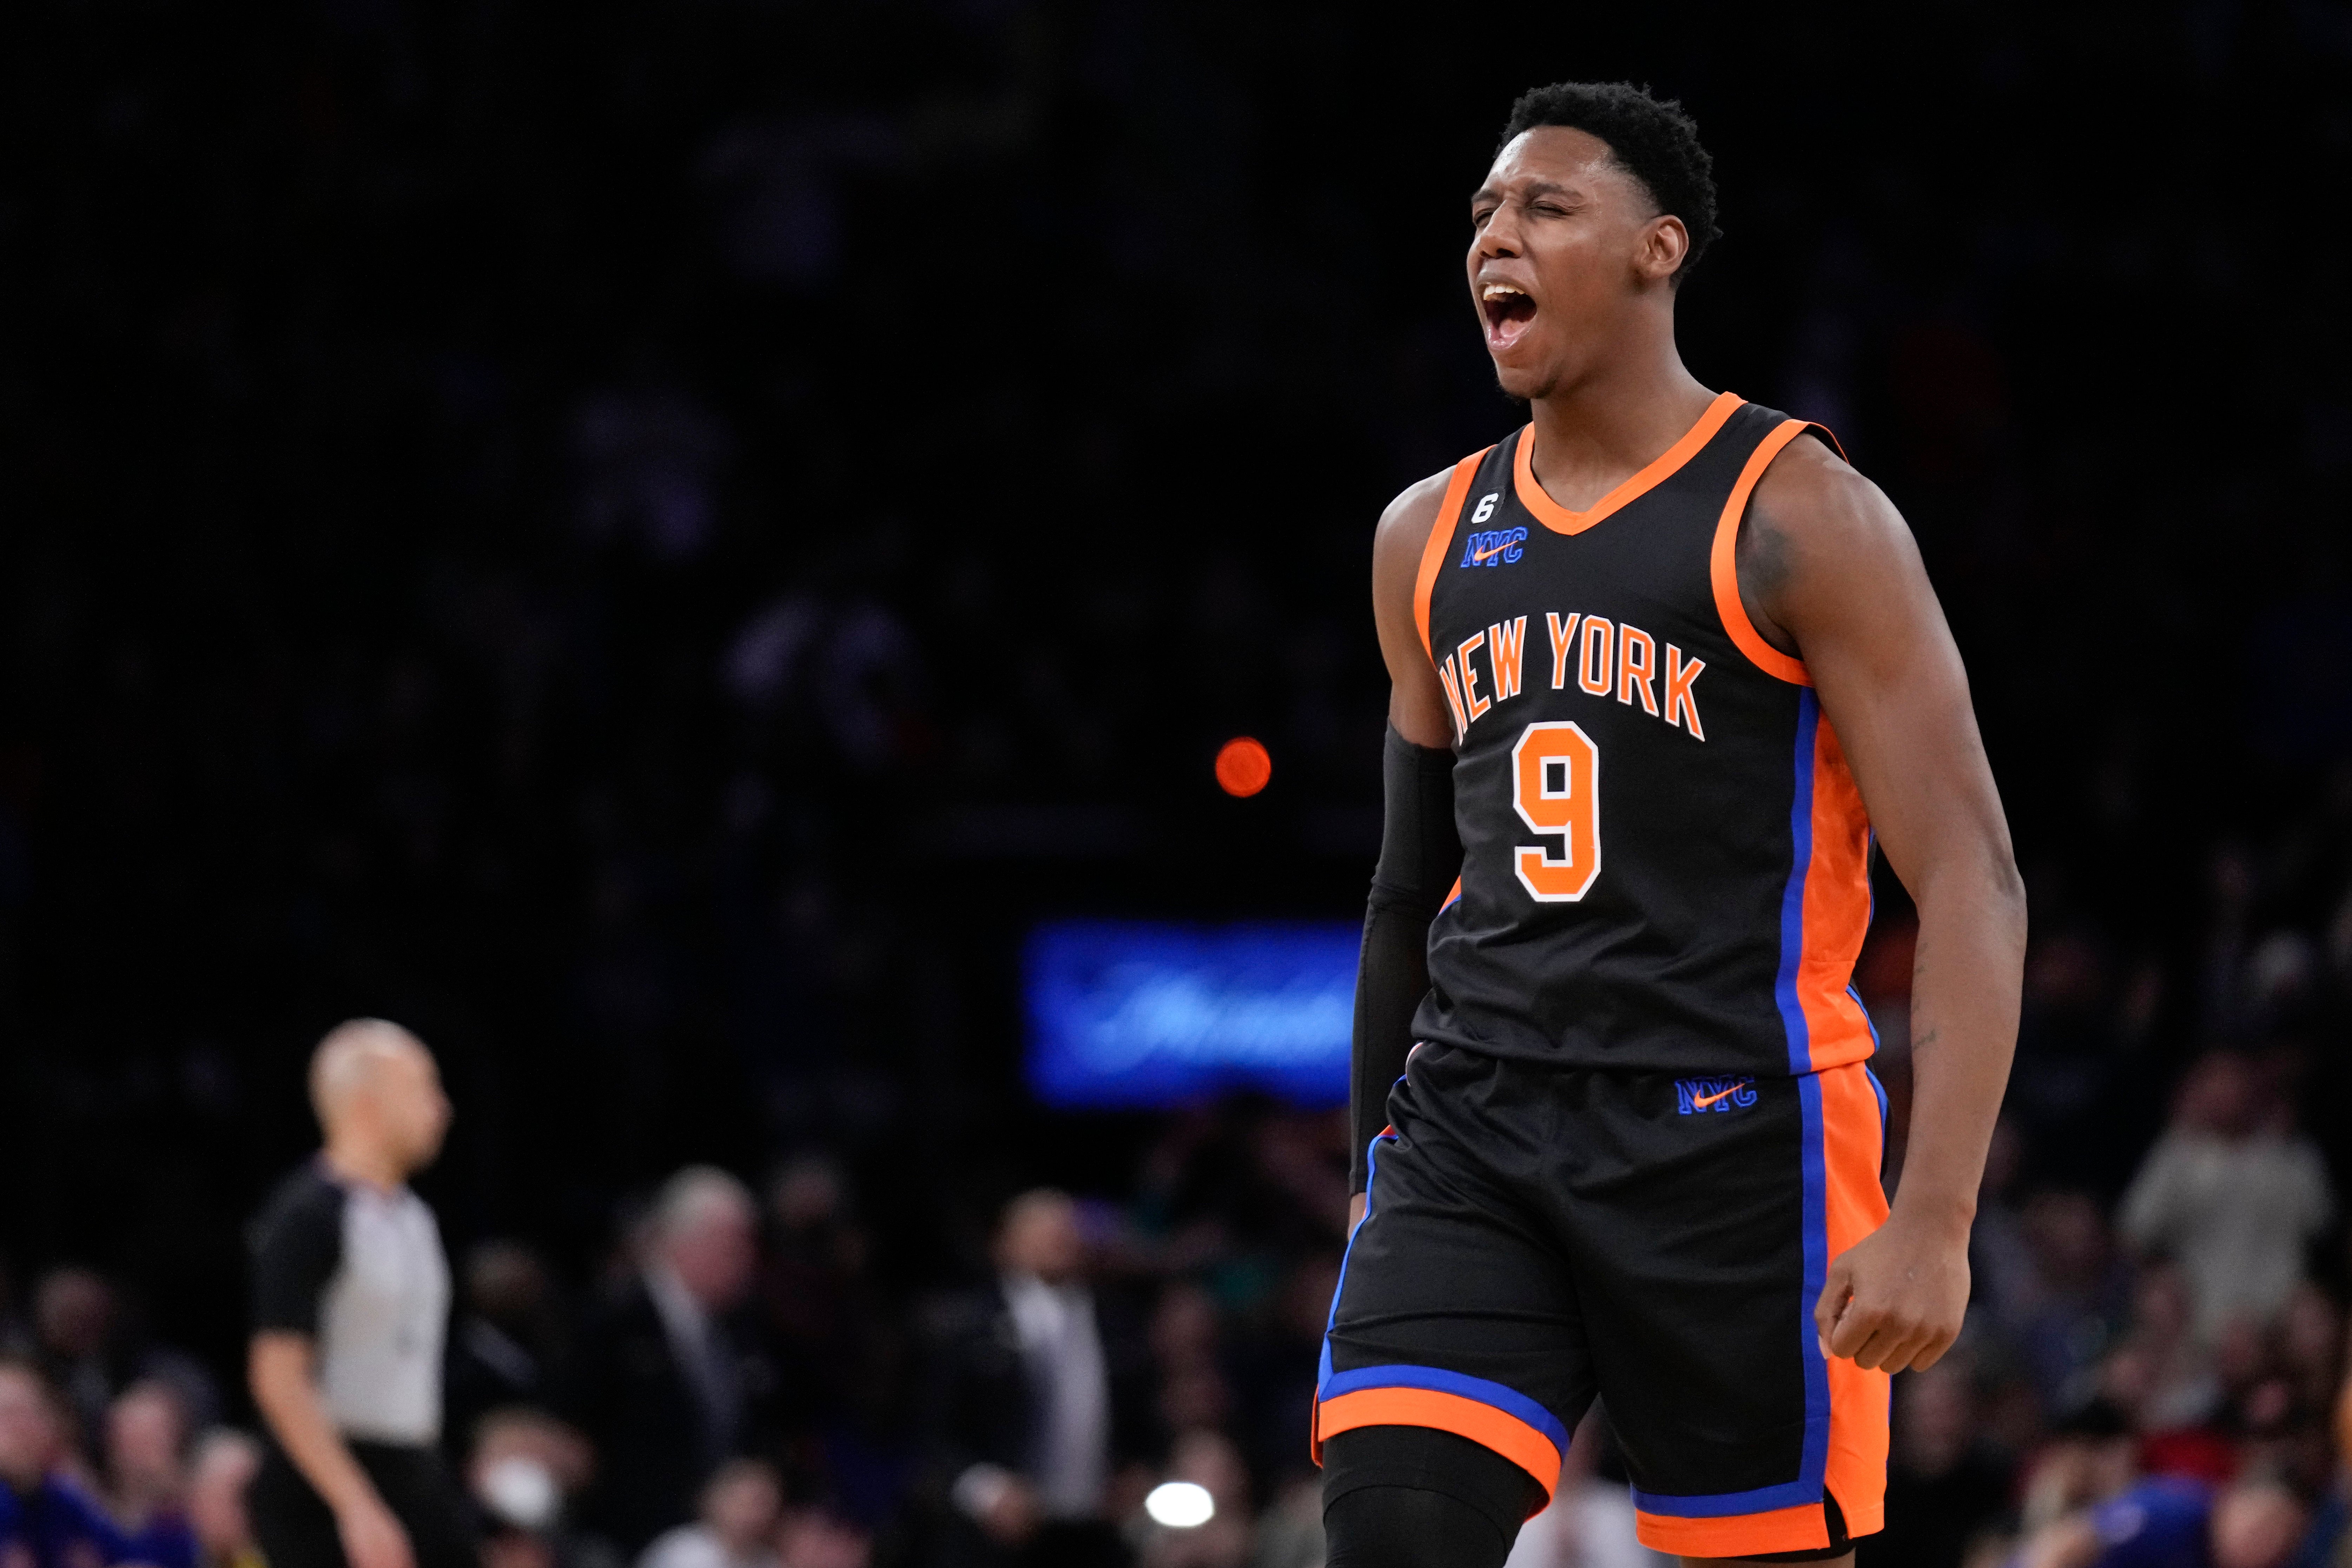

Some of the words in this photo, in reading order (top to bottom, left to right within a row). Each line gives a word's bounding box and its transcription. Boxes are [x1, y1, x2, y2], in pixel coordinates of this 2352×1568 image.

[1471, 492, 1499, 524] 6
[1460, 526, 1528, 568] NYC
[1439, 615, 1527, 746] NEW
[1546, 612, 1706, 742] YORK
[1512, 721, 1601, 902] 9
[1674, 1074, 1757, 1115] NYC
